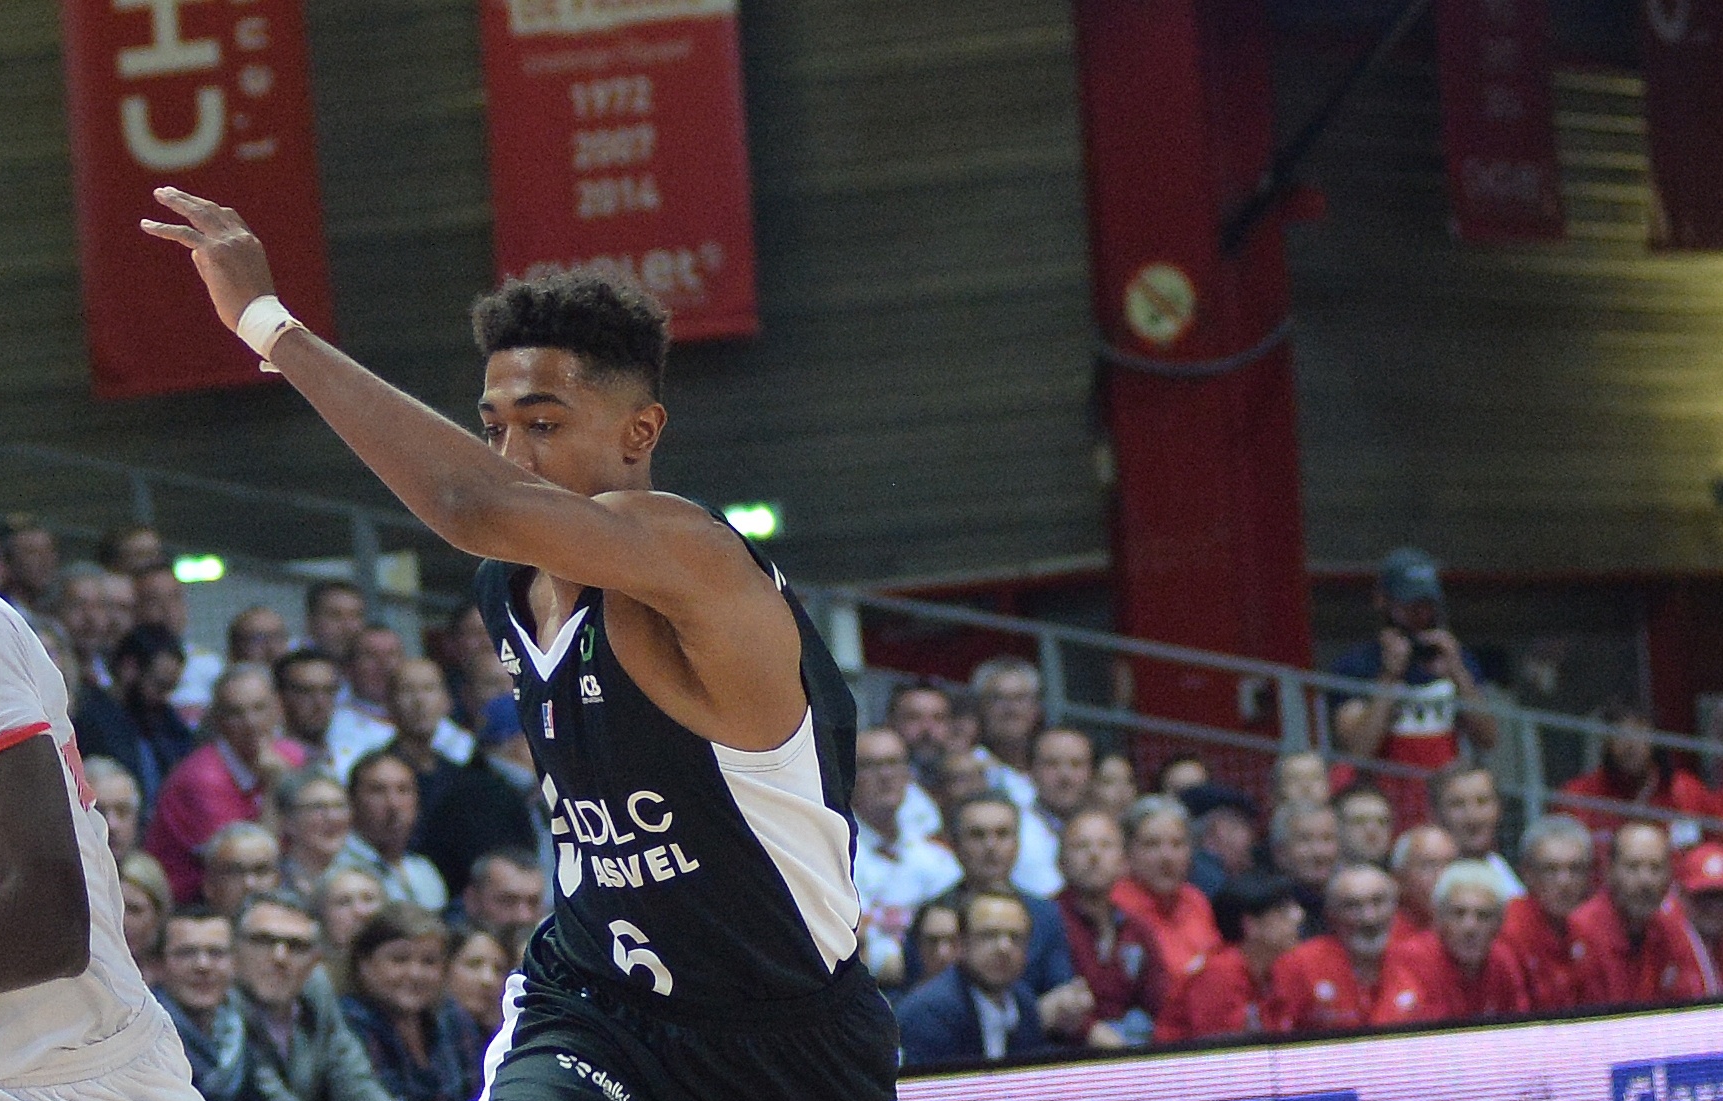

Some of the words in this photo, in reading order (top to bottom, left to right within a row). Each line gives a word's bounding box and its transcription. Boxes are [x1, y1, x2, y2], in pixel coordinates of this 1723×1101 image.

[562, 790, 673, 846] LDLC
[591, 843, 700, 889] ASVEL
[608, 919, 674, 997] 6
